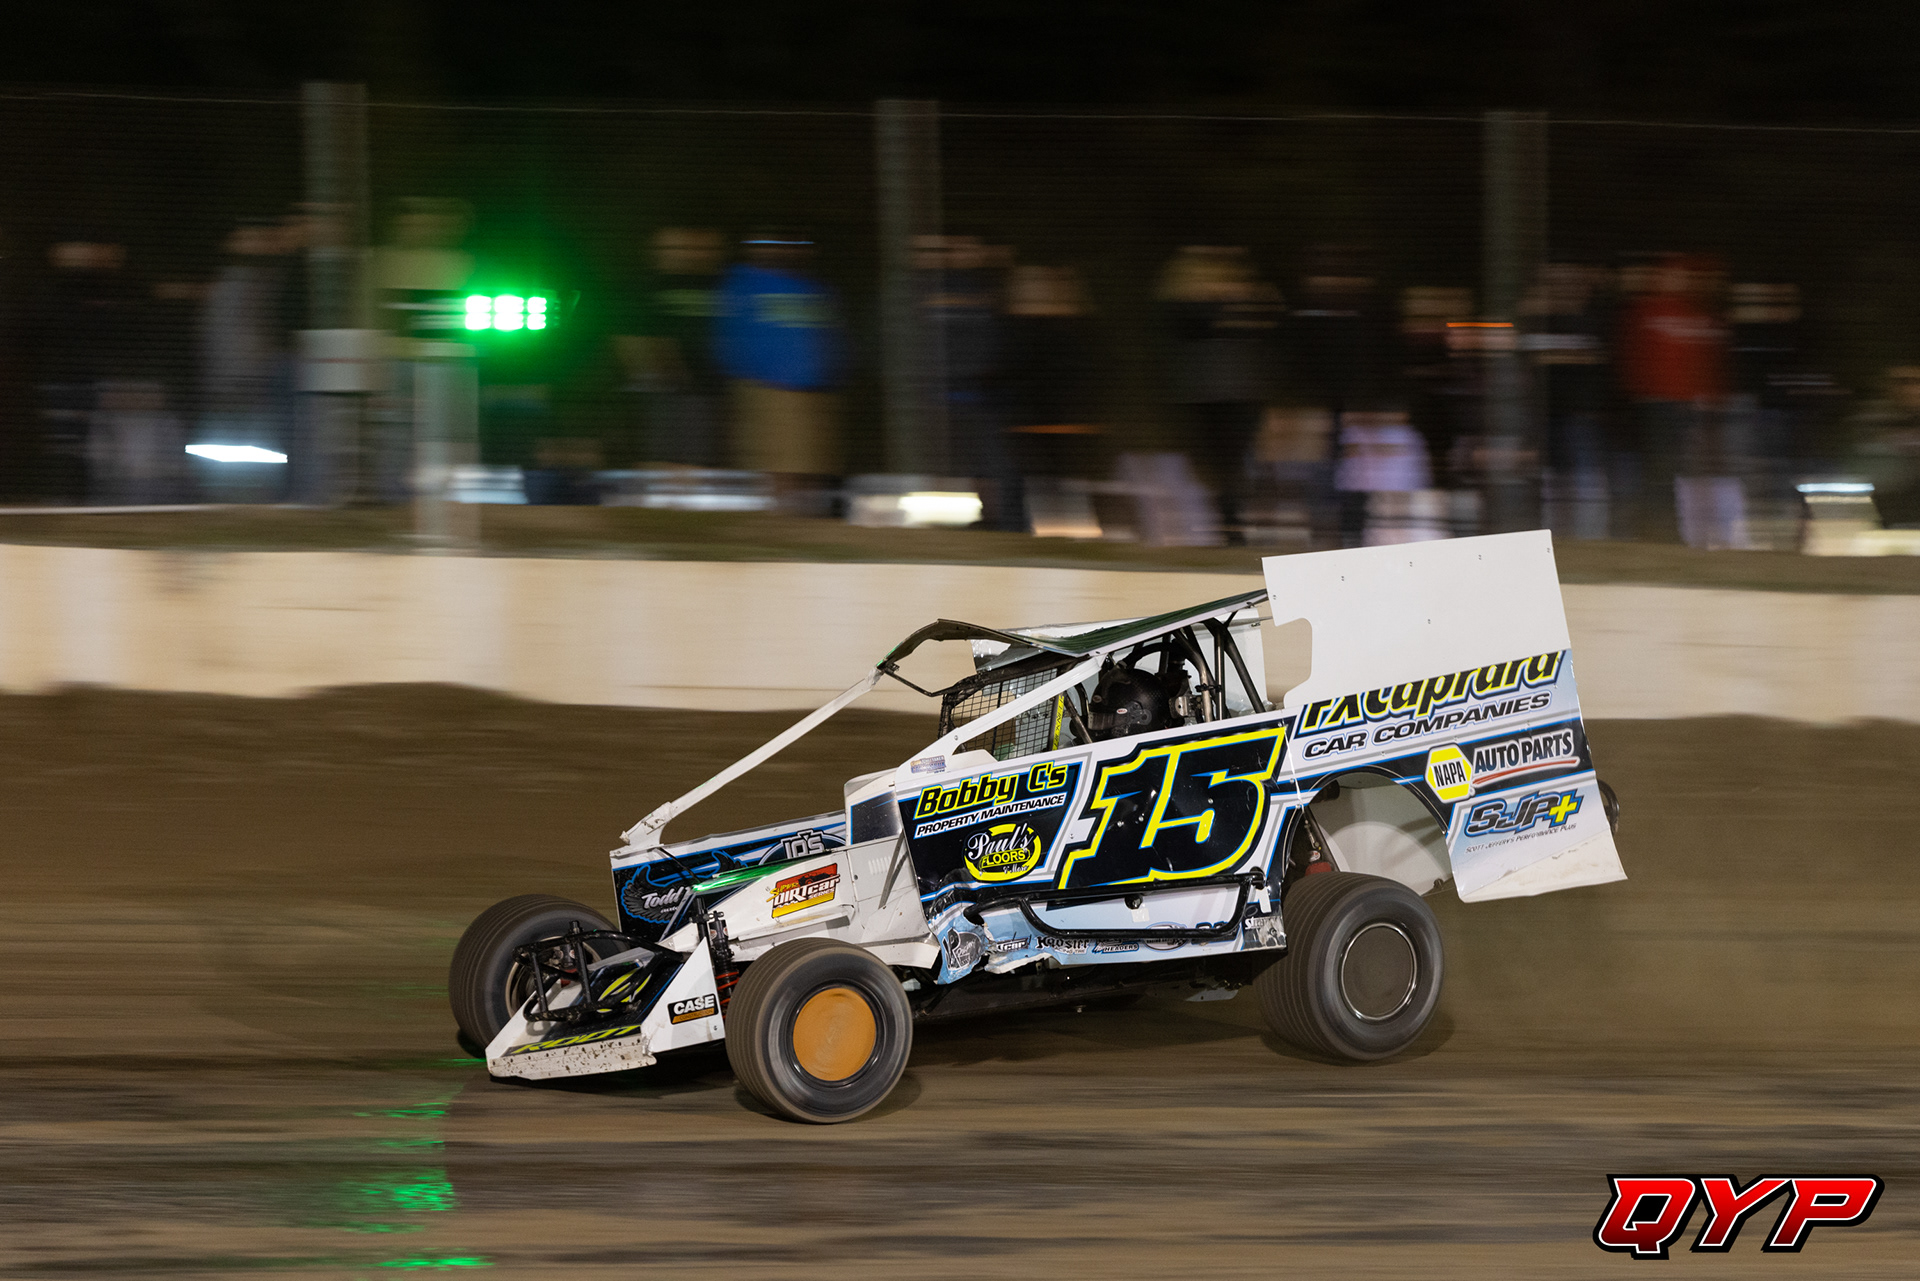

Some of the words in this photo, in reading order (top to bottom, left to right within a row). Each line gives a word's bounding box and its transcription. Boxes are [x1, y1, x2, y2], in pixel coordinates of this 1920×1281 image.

[1304, 732, 1367, 759] CAR
[1373, 692, 1551, 744] COMPANIES
[1433, 760, 1467, 787] NAPA
[1475, 743, 1520, 774] AUTO
[1521, 731, 1573, 764] PARTS
[915, 774, 1019, 819] Bobby
[1028, 761, 1069, 792] C's
[917, 812, 980, 834] PROPERTY
[980, 794, 1065, 820] MAINTENANCE
[1059, 727, 1287, 889] 15
[967, 823, 1034, 860] Paul's
[1559, 822, 1577, 832] PLUS
[981, 850, 1027, 867] FLOORS
[641, 886, 685, 909] Todd
[767, 882, 799, 902] SUPER
[1103, 943, 1138, 952] HEADERS
[673, 994, 715, 1015] CASE
